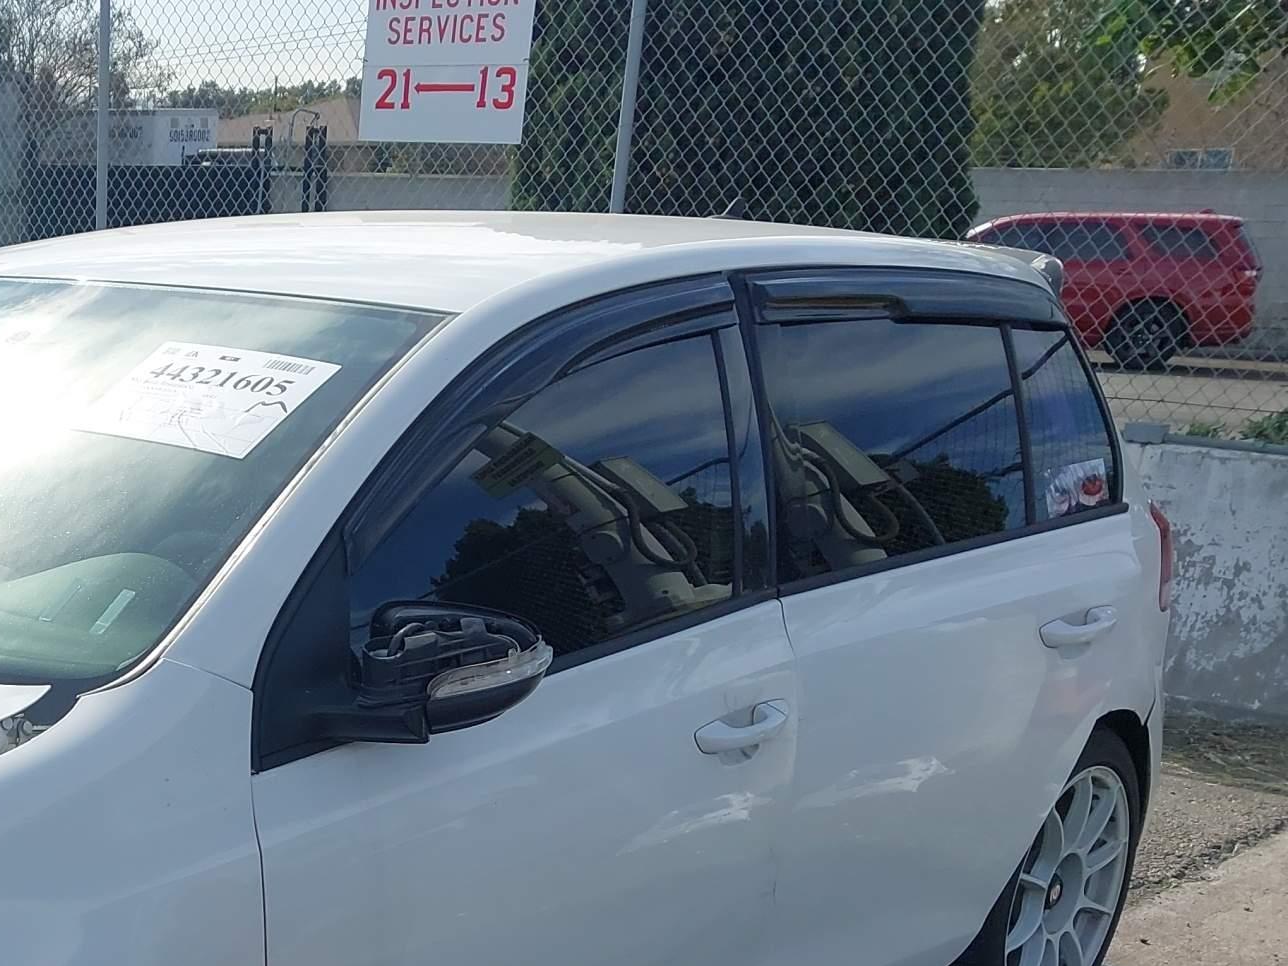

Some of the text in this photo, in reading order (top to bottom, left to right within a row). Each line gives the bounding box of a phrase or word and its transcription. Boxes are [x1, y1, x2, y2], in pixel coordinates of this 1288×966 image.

[387, 12, 506, 45] SERVICES
[374, 65, 518, 110] 21 13
[149, 361, 296, 397] 44321605
